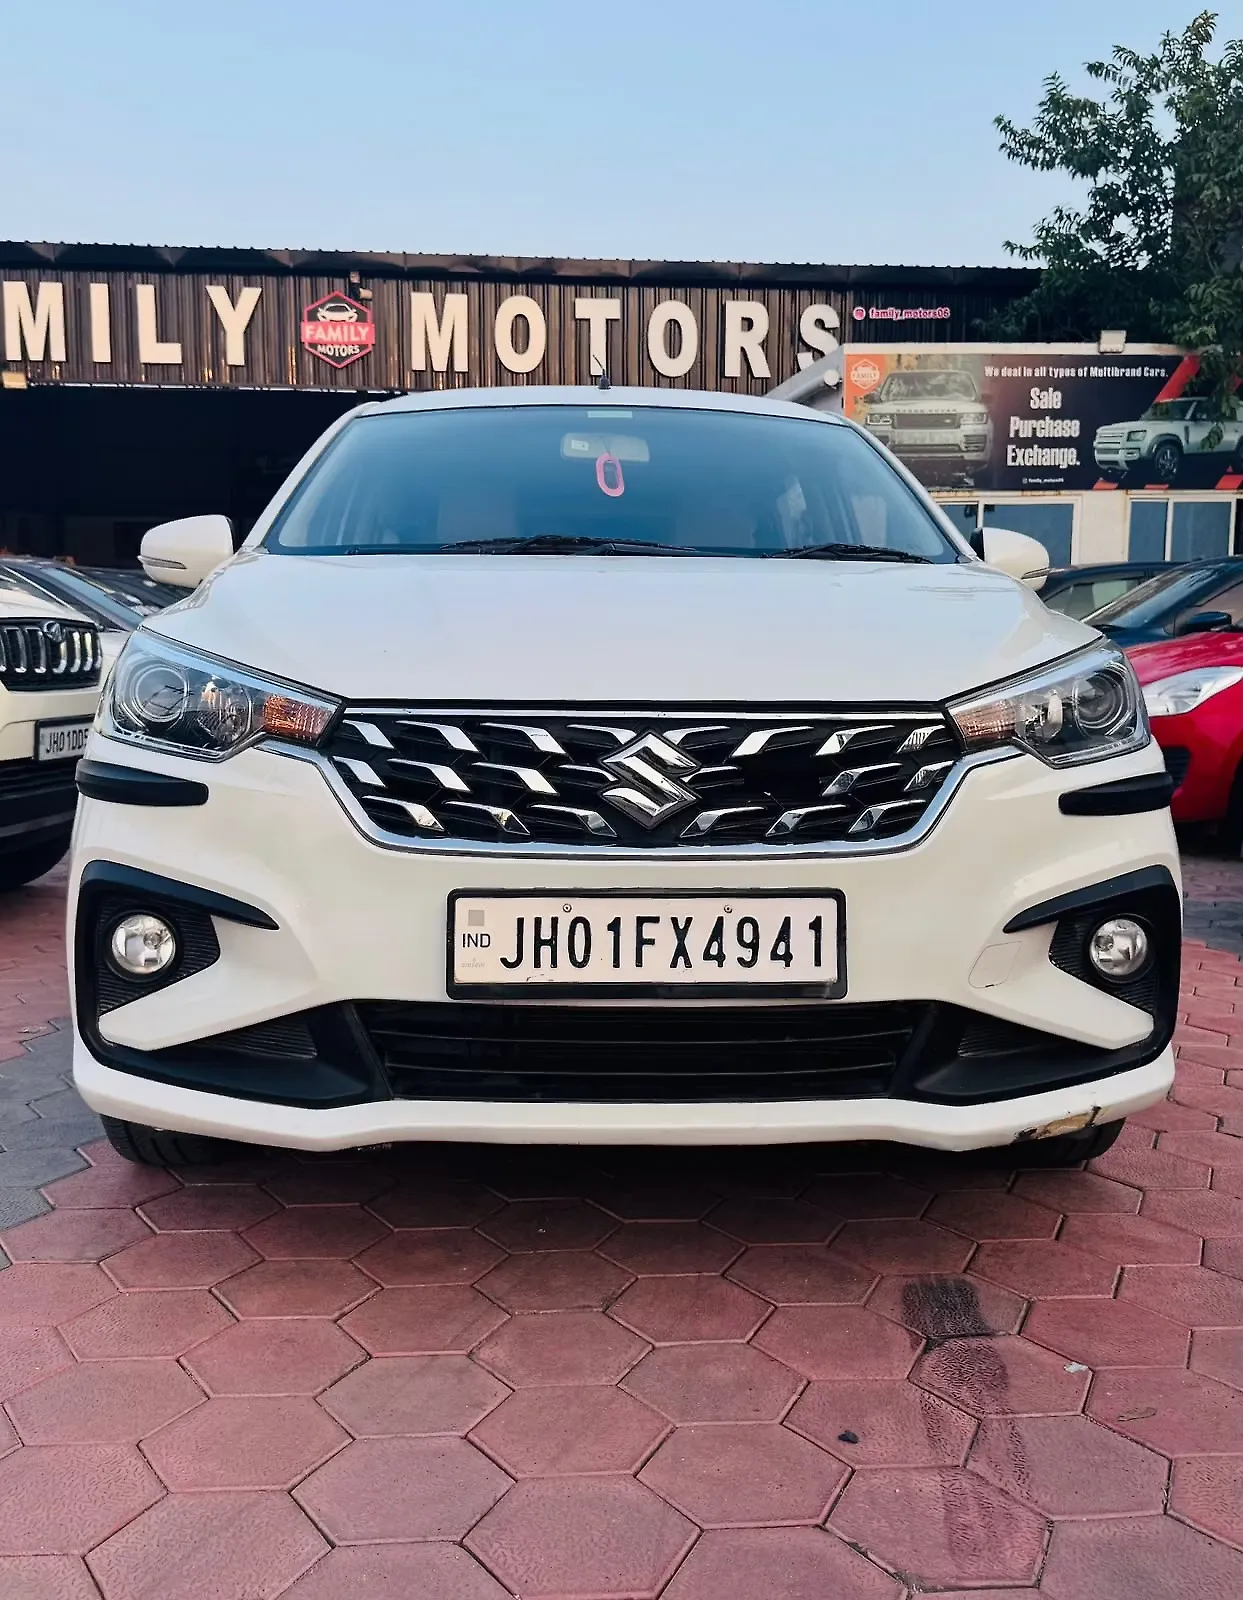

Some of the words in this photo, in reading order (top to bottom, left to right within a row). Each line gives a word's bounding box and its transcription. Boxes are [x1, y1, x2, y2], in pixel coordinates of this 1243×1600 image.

[3, 280, 263, 367] MILY
[410, 291, 840, 379] MOTORS
[305, 324, 370, 342] FAMILY
[316, 344, 360, 357] MOTORS
[984, 366, 999, 377] We
[1001, 366, 1021, 377] deal
[1034, 366, 1046, 377] all
[1049, 366, 1076, 379] types
[1077, 366, 1088, 377] of
[1089, 366, 1142, 378] Multibrand
[1030, 387, 1062, 409] Sale
[1009, 415, 1081, 438] Purchase
[1006, 444, 1081, 469] Exchange.
[462, 933, 491, 948] IND
[499, 915, 823, 969] JH01FX4941
